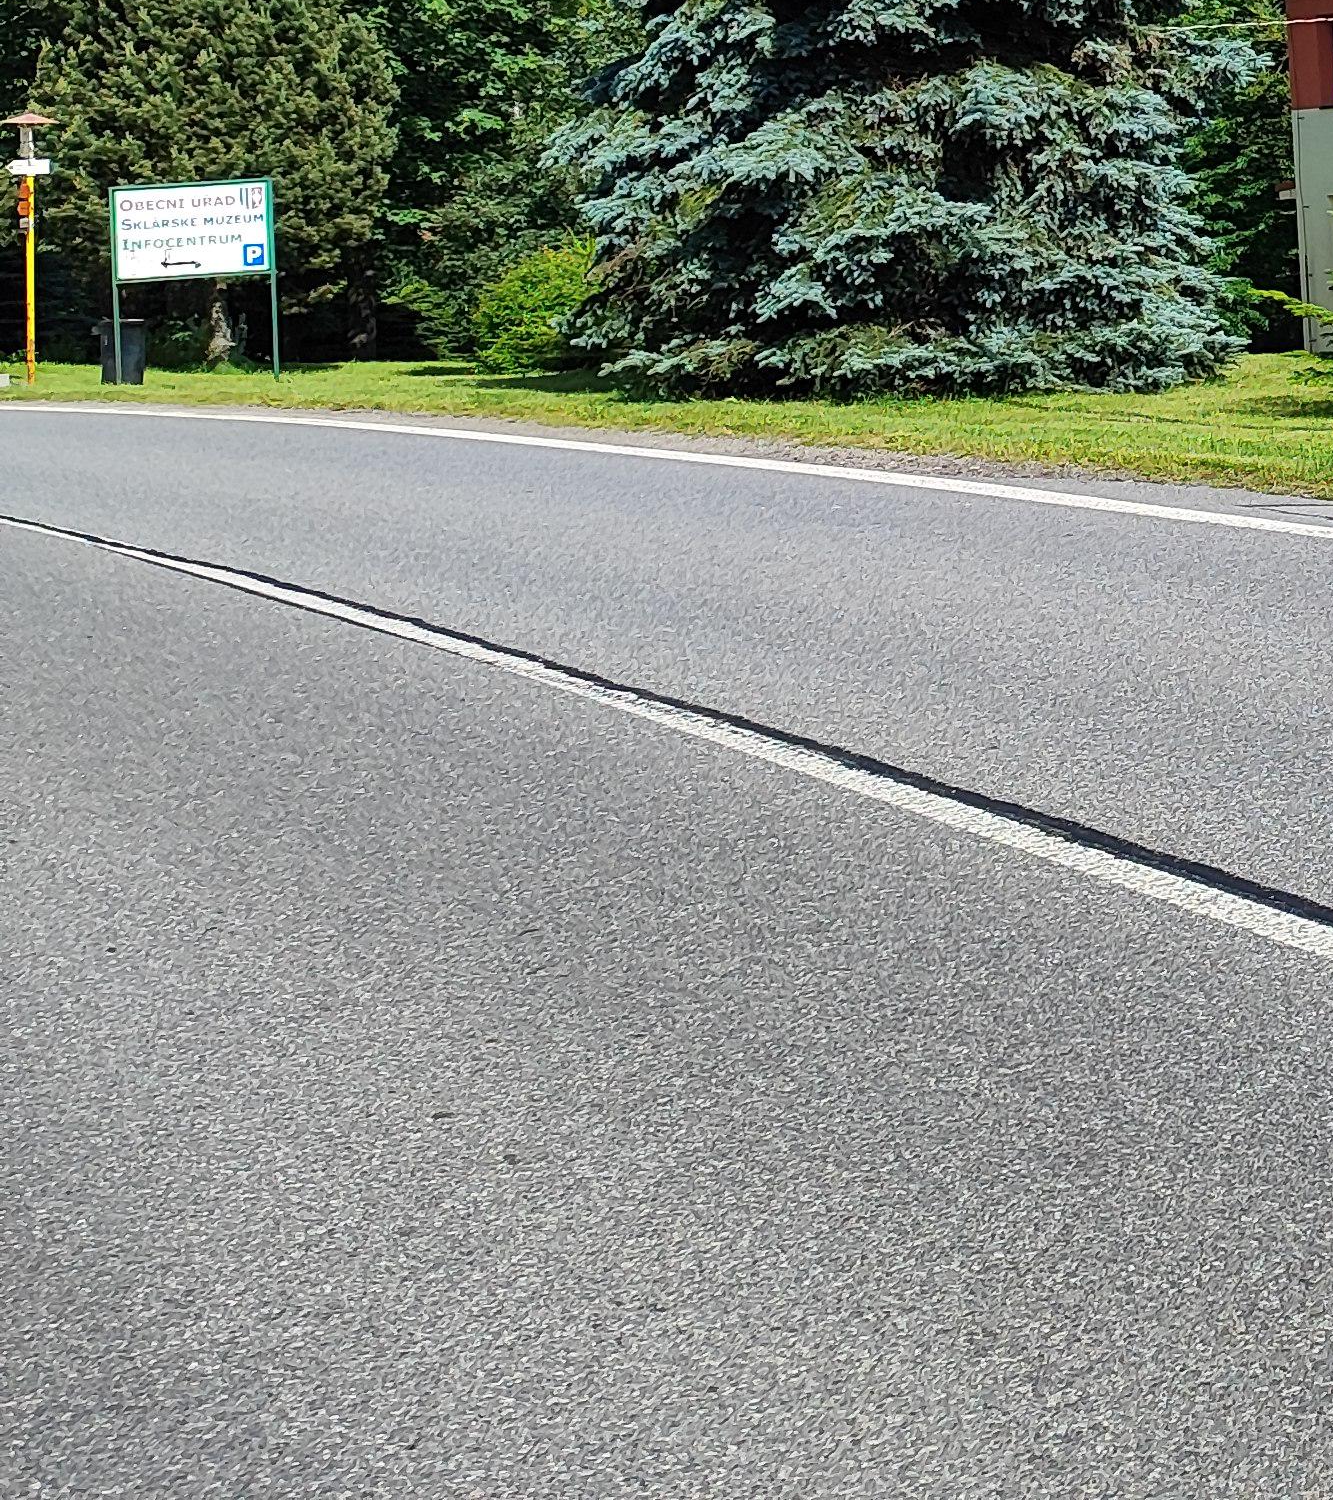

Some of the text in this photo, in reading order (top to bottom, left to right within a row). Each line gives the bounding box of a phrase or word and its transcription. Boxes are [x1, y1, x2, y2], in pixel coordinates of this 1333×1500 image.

[203, 213, 264, 225] MUZEUM
[122, 234, 242, 250] INFOCENTRUM
[246, 245, 262, 264] P
